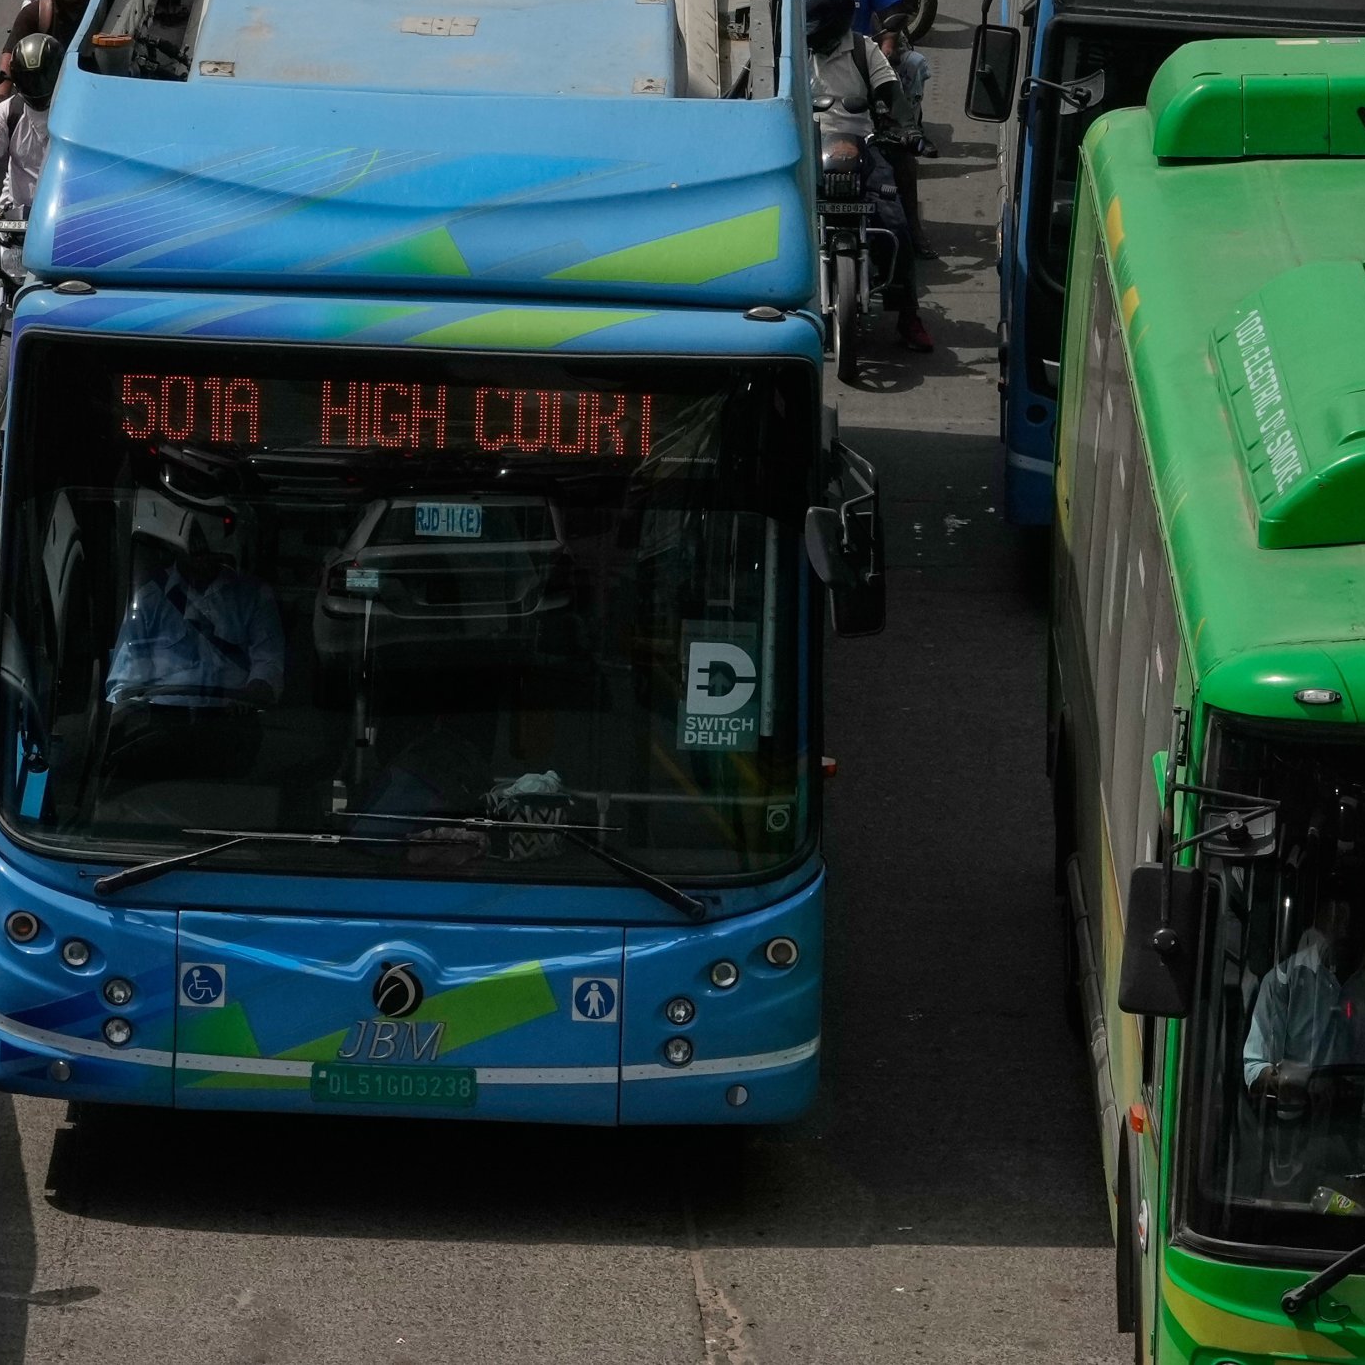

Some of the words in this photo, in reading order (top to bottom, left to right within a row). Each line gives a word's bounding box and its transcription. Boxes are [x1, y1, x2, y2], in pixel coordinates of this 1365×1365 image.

[122, 374, 258, 443] 501A
[322, 381, 446, 448] HIGH
[684, 732, 738, 747] DELHI
[685, 718, 754, 733] SWITCH
[338, 1020, 447, 1062] JBM
